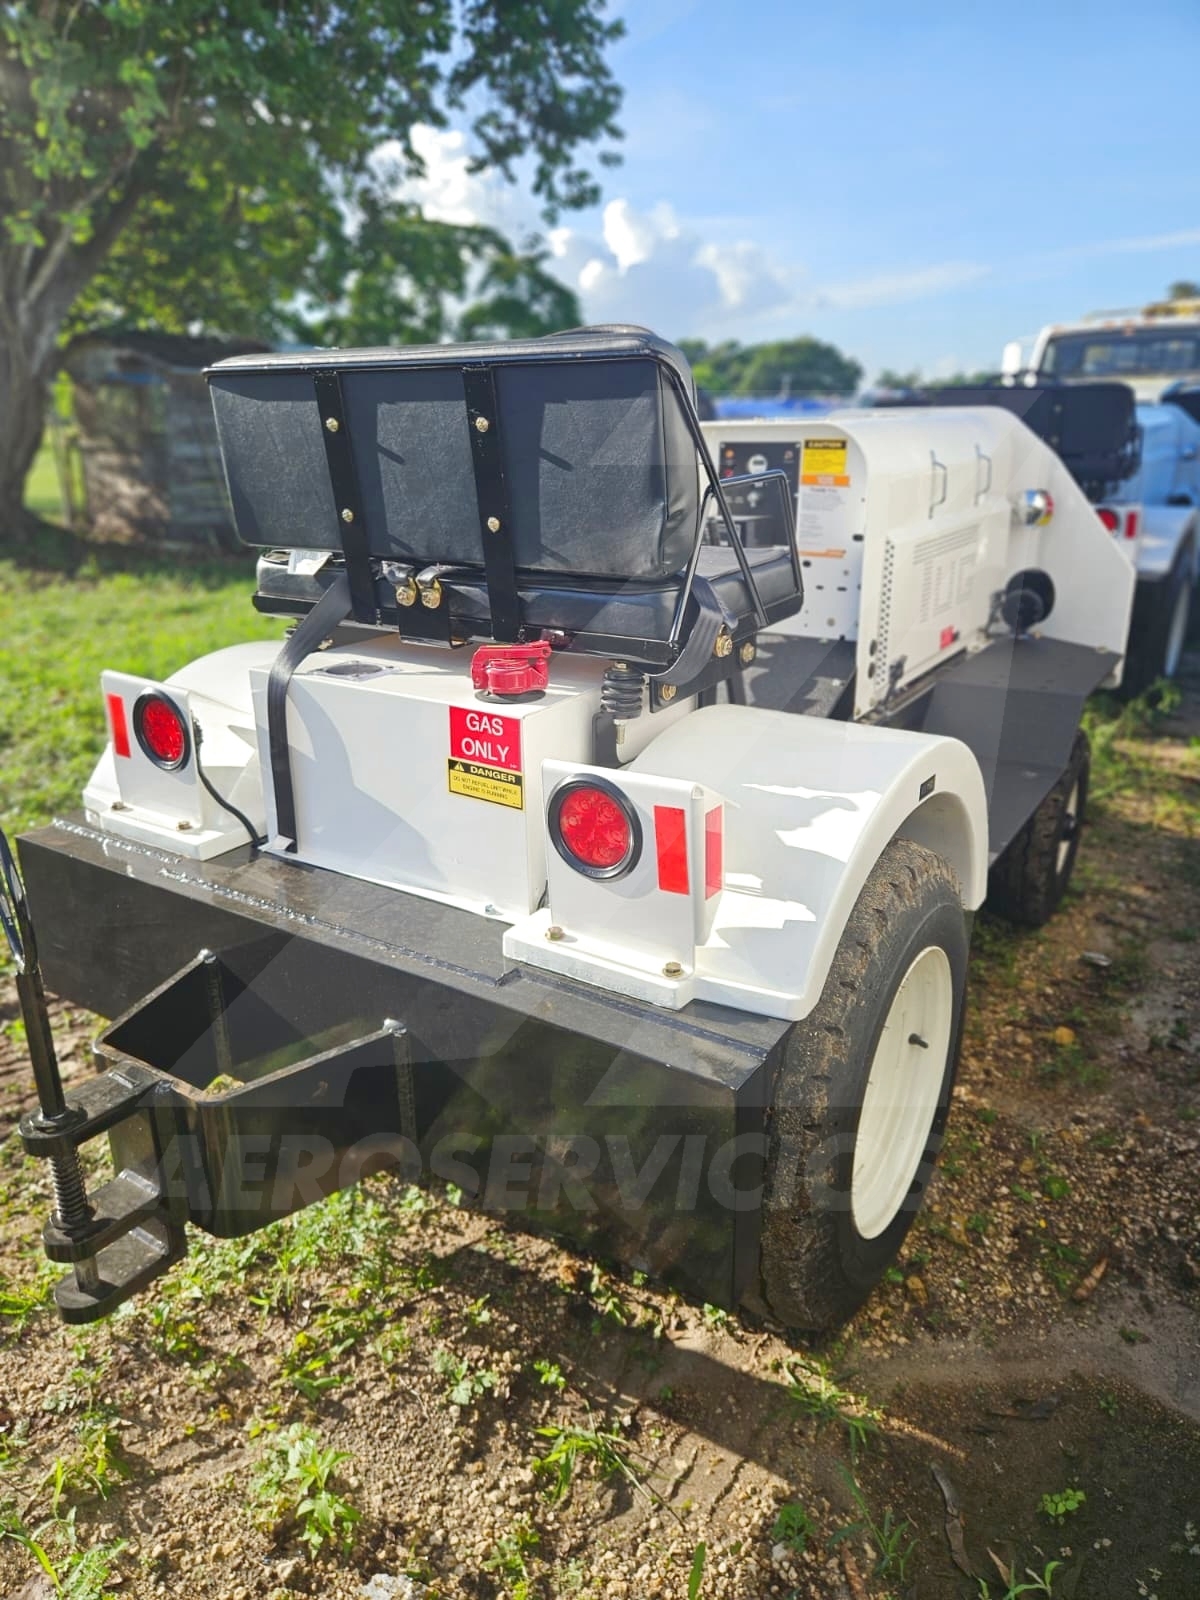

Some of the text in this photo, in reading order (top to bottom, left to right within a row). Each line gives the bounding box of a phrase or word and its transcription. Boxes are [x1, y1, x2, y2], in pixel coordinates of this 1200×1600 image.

[466, 713, 503, 736] GAS
[461, 737, 509, 762] ONLY
[470, 766, 515, 783] DANGER
